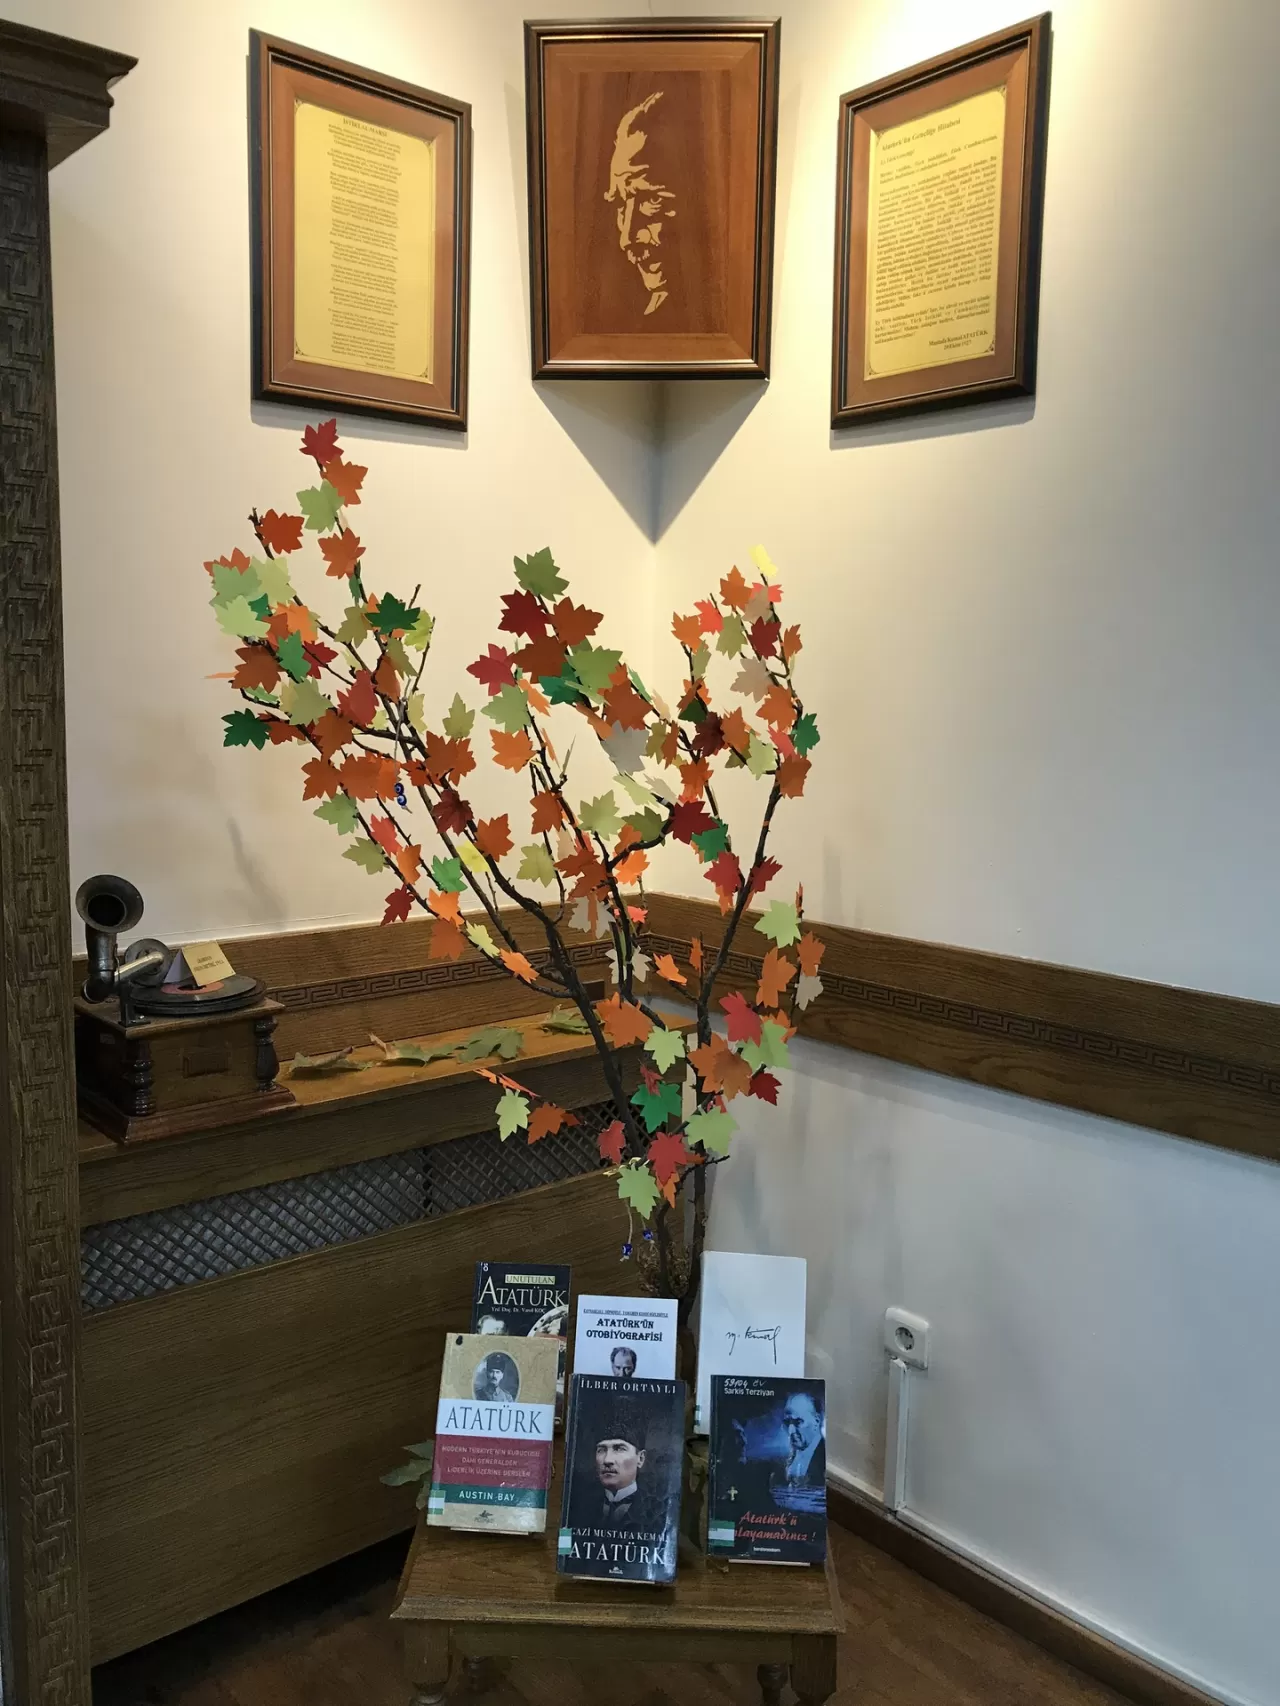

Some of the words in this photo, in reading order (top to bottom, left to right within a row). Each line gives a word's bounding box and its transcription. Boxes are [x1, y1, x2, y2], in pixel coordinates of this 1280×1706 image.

[506, 1275, 555, 1284] UNUTULAN
[597, 1318, 655, 1329] ATATÜRK'ÜN
[586, 1330, 663, 1342] OTOBİYOGRAFİSİ
[580, 1378, 617, 1390] İLBER
[623, 1382, 676, 1394] ORTAYLI
[724, 1387, 744, 1395] Sarkis
[746, 1388, 775, 1397] Terziyan
[445, 1405, 542, 1434] ATATÜRK
[477, 1458, 518, 1466] GENERALDEN
[459, 1491, 493, 1500] AUSTIN
[497, 1493, 515, 1502] BAY
[739, 1510, 798, 1526] Atatürk'ü
[593, 1529, 635, 1540] MUSTAFA
[569, 1541, 666, 1565] ATATÜRK
